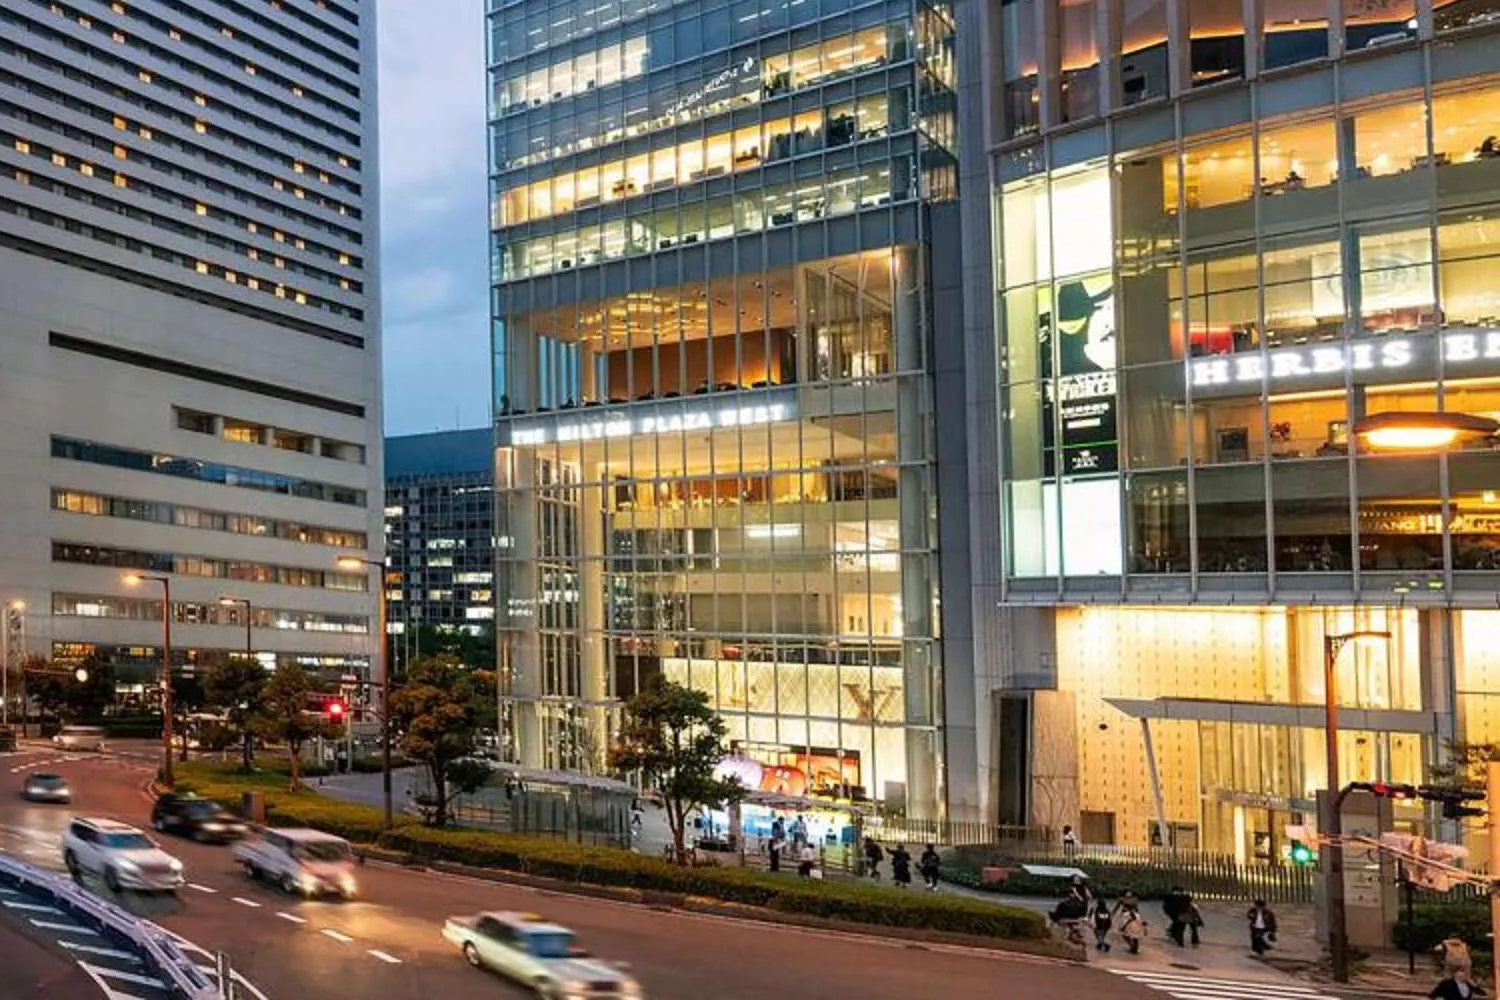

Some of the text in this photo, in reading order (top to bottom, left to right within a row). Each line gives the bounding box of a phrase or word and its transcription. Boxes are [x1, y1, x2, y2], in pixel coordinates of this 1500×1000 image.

[1192, 340, 1412, 385] HERBIS
[557, 420, 631, 442] HILTON
[642, 412, 712, 433] PLAZA
[719, 403, 785, 426] WEST
